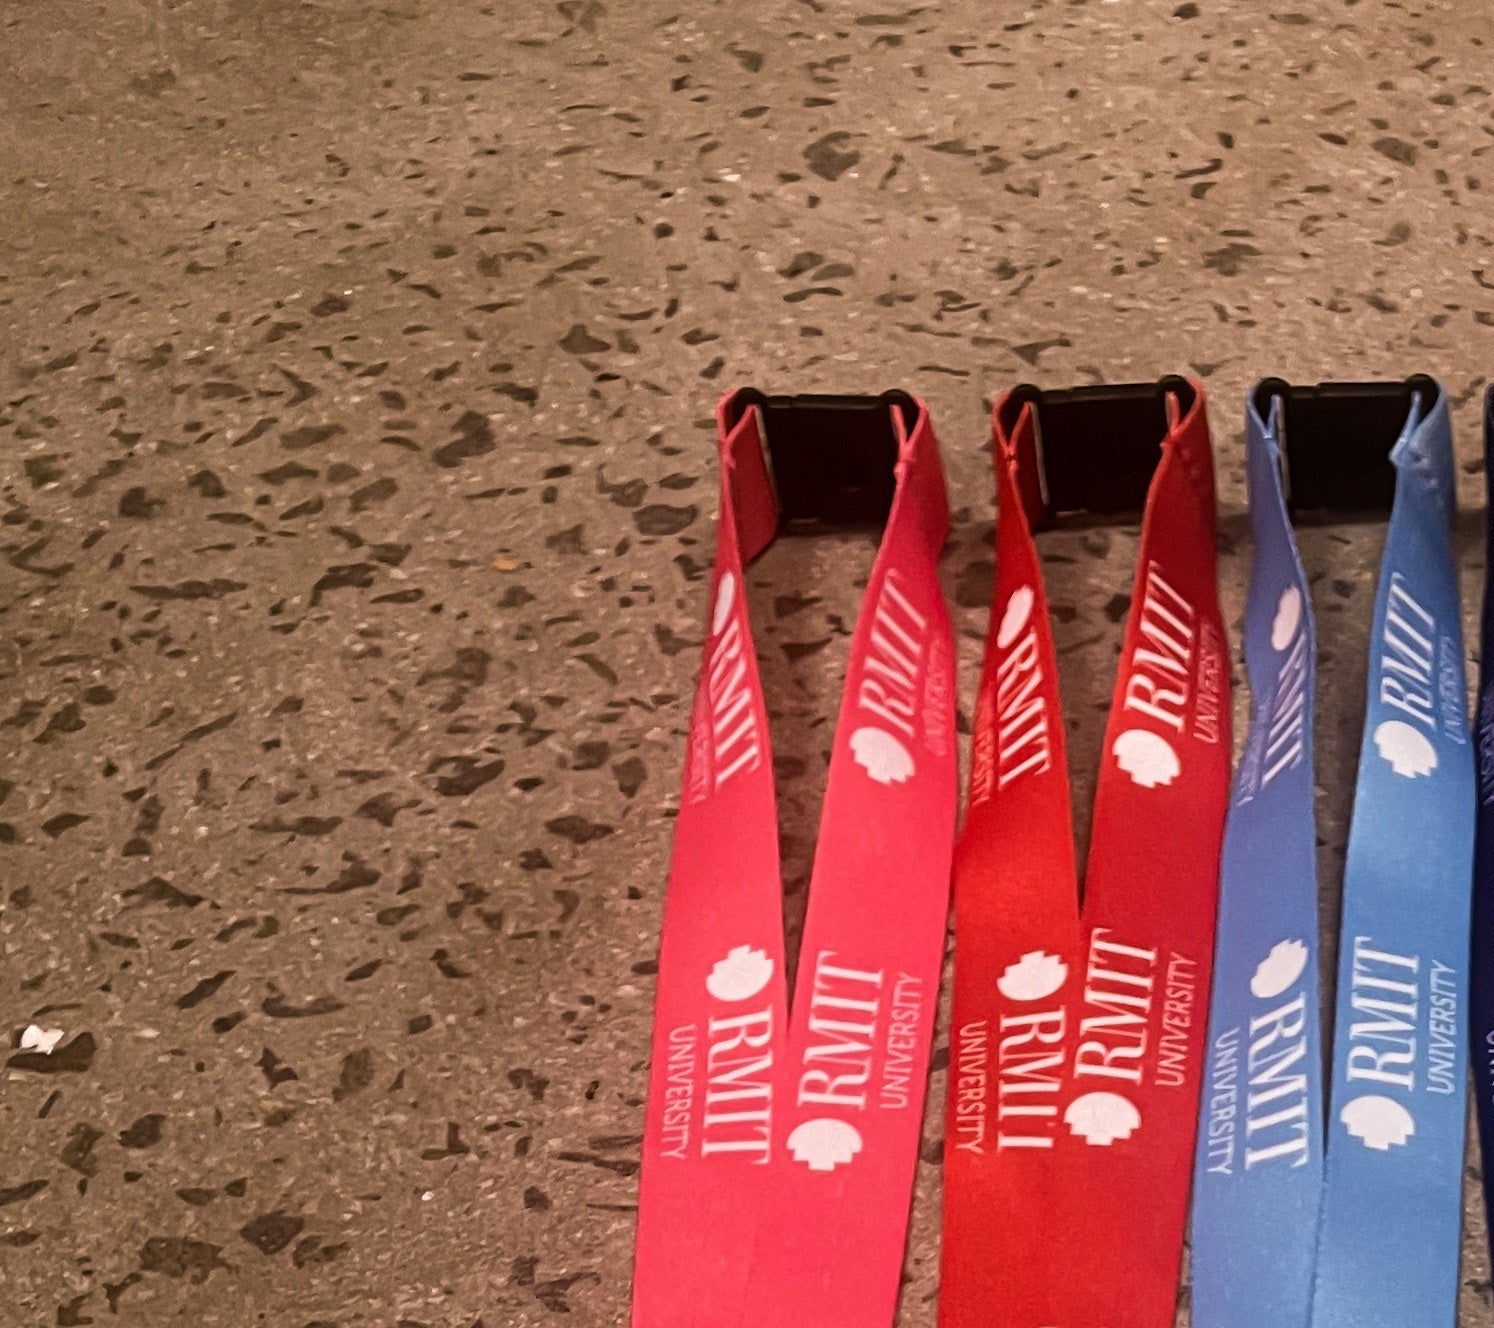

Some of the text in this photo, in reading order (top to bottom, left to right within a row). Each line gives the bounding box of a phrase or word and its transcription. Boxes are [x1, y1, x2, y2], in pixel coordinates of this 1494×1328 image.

[859, 568, 927, 738] RMIT
[996, 625, 1051, 792] RMIT
[1125, 559, 1195, 734] RMIT
[1381, 572, 1436, 731] RMIT
[701, 1004, 774, 1165] RMIT
[797, 950, 884, 1110] RMIT
[880, 971, 924, 1110] UNIVERSITY
[1074, 927, 1158, 1084] RMIT
[1154, 950, 1198, 1088] UNIVERSITY
[1245, 992, 1310, 1171] RMIT
[1346, 935, 1421, 1093] RMIT
[1426, 959, 1459, 1097] UNIVERSITY
[660, 1024, 697, 1160] UNIVERSITY
[954, 1019, 989, 1154] UNIVERSITY
[1207, 1026, 1241, 1176] UNIVERSITY
